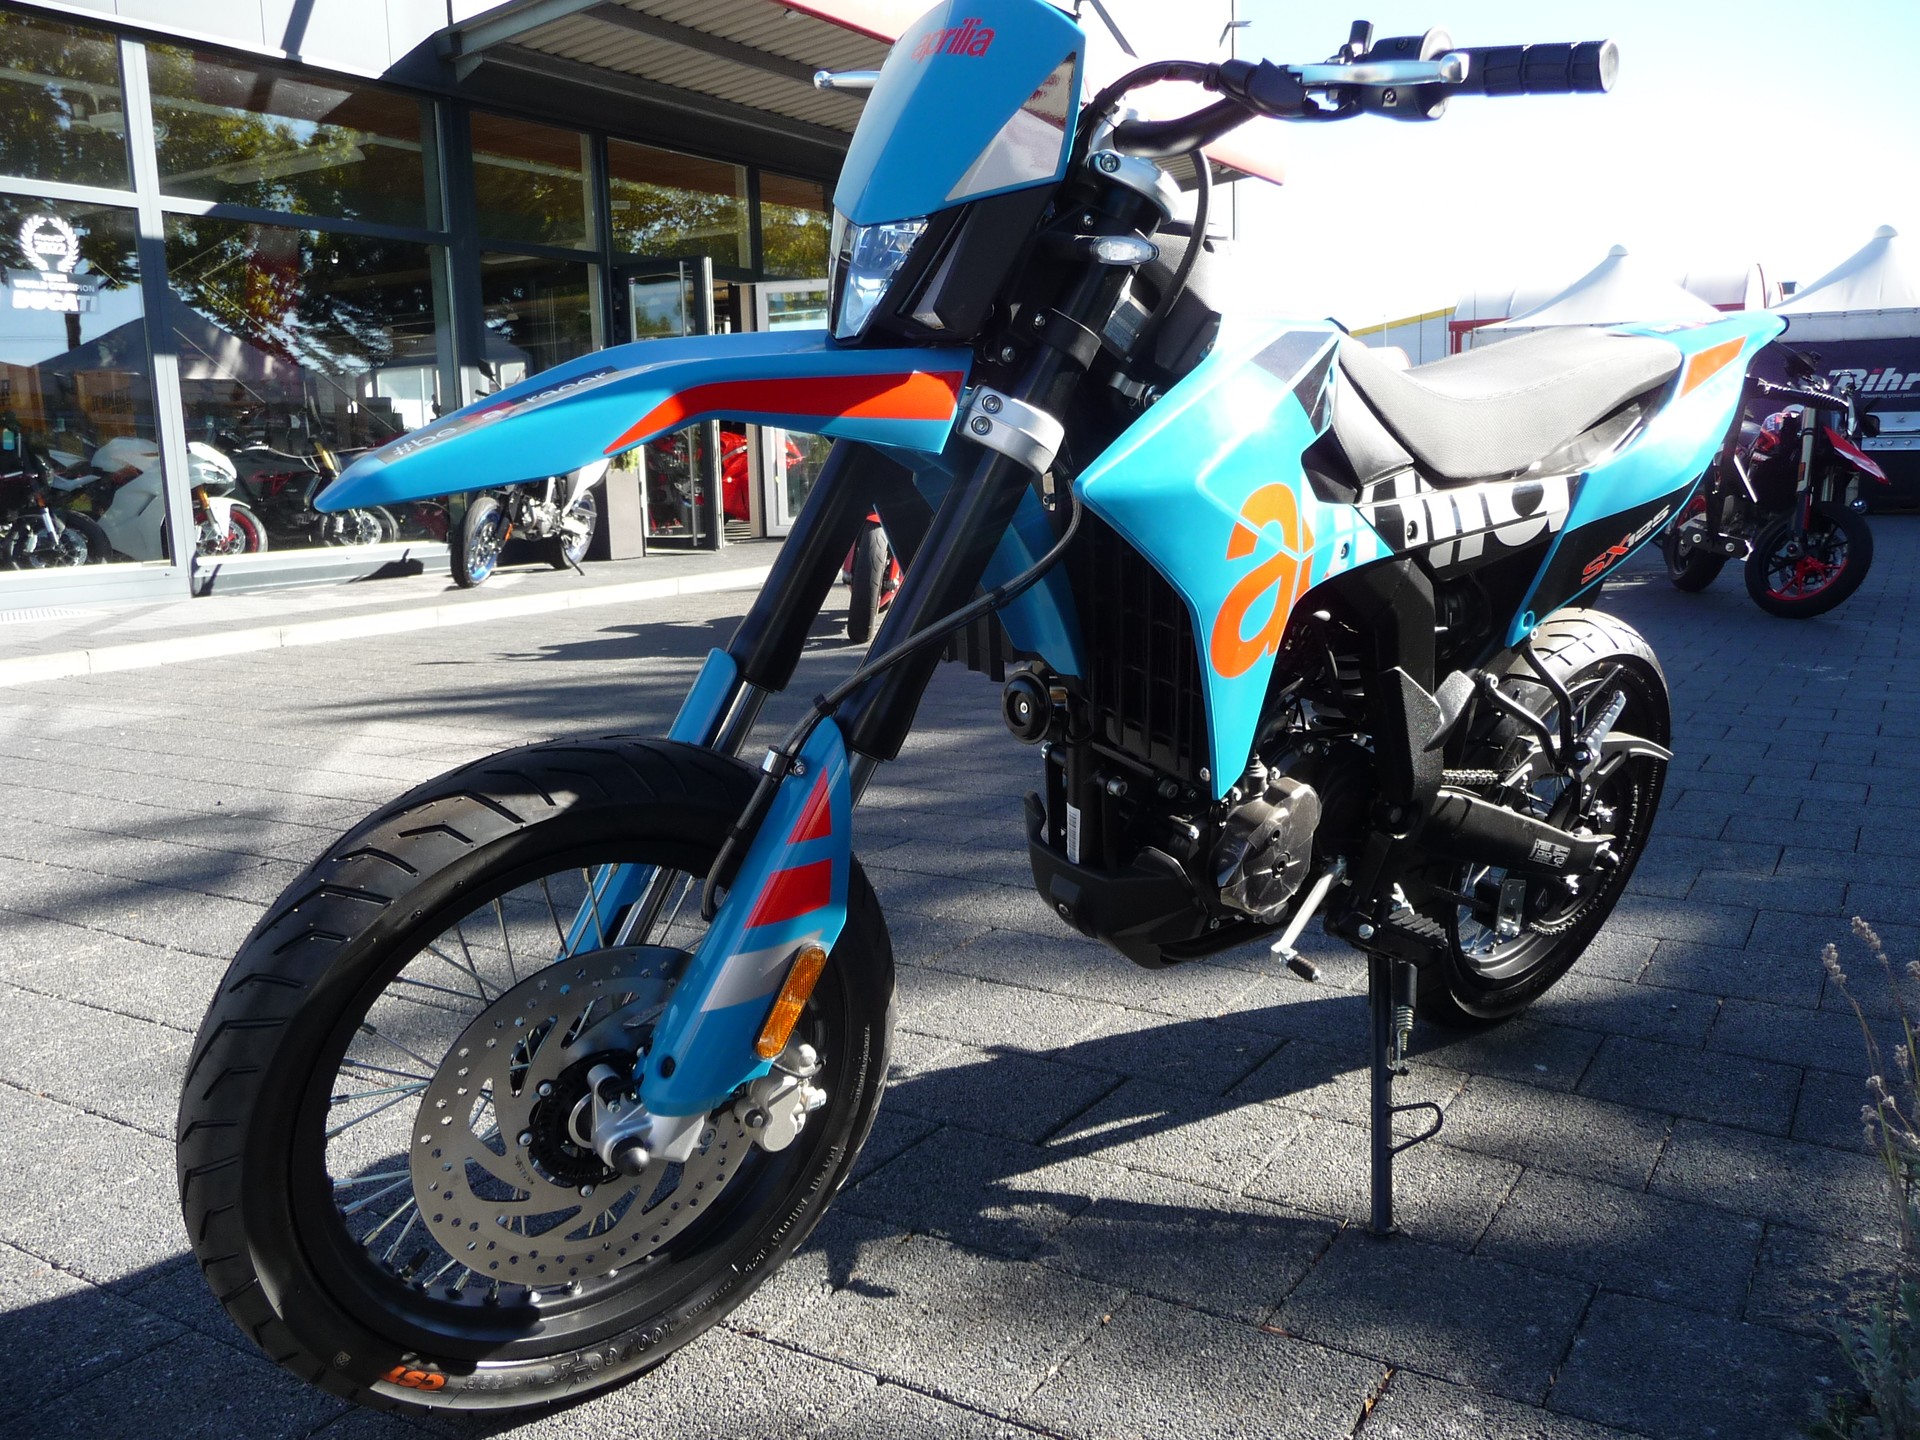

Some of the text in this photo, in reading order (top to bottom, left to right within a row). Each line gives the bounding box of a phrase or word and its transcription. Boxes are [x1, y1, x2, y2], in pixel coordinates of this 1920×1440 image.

[911, 16, 995, 64] aprilia
[34, 241, 68, 255] 2022
[13, 279, 95, 293] WORLD CHAMPION
[12, 289, 97, 312] DUCATI
[1828, 367, 1920, 392] Bihr
[1581, 504, 1671, 585] SX125
[383, 1364, 446, 1391] CST
